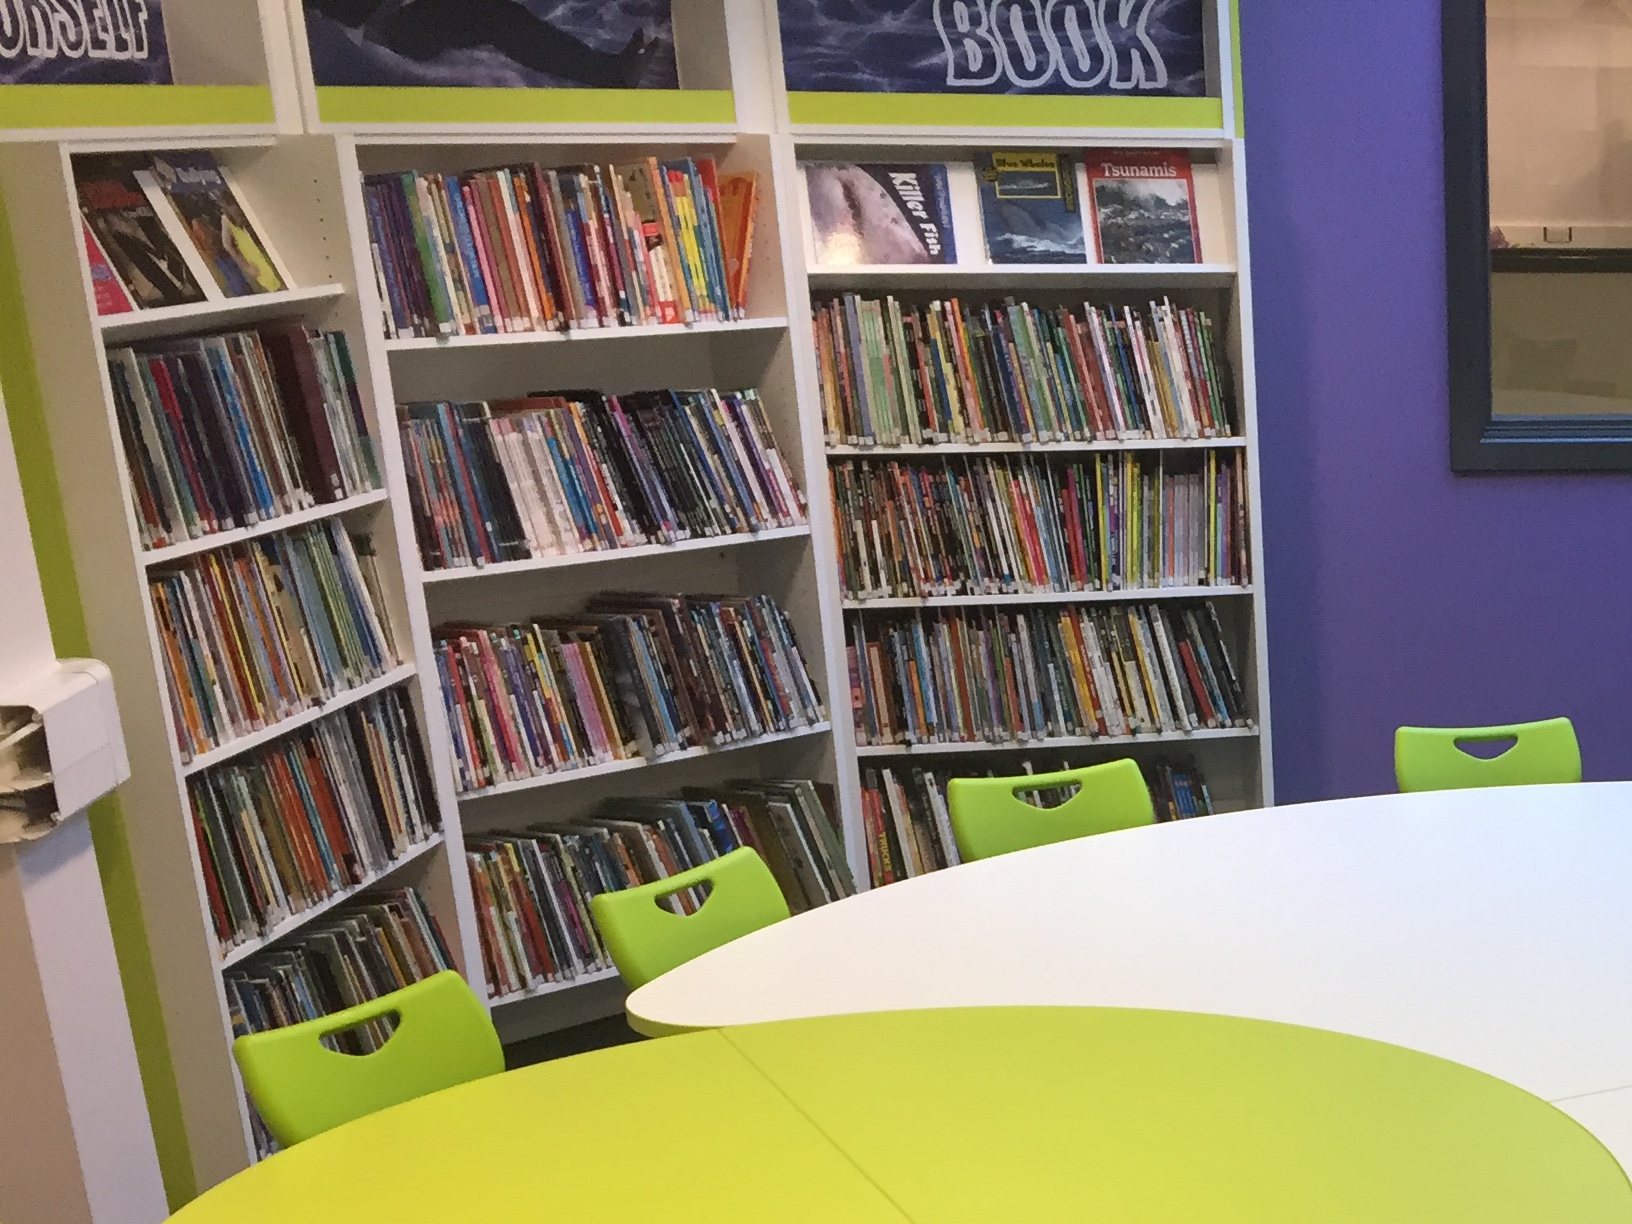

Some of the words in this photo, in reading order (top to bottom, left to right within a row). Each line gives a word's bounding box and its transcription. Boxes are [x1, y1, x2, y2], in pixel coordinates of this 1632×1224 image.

[933, 0, 1168, 89] BOOK
[1100, 161, 1177, 177] Tsunamis
[887, 172, 929, 219] Killer
[919, 222, 941, 255] Fish
[878, 831, 892, 872] TRUCKS
